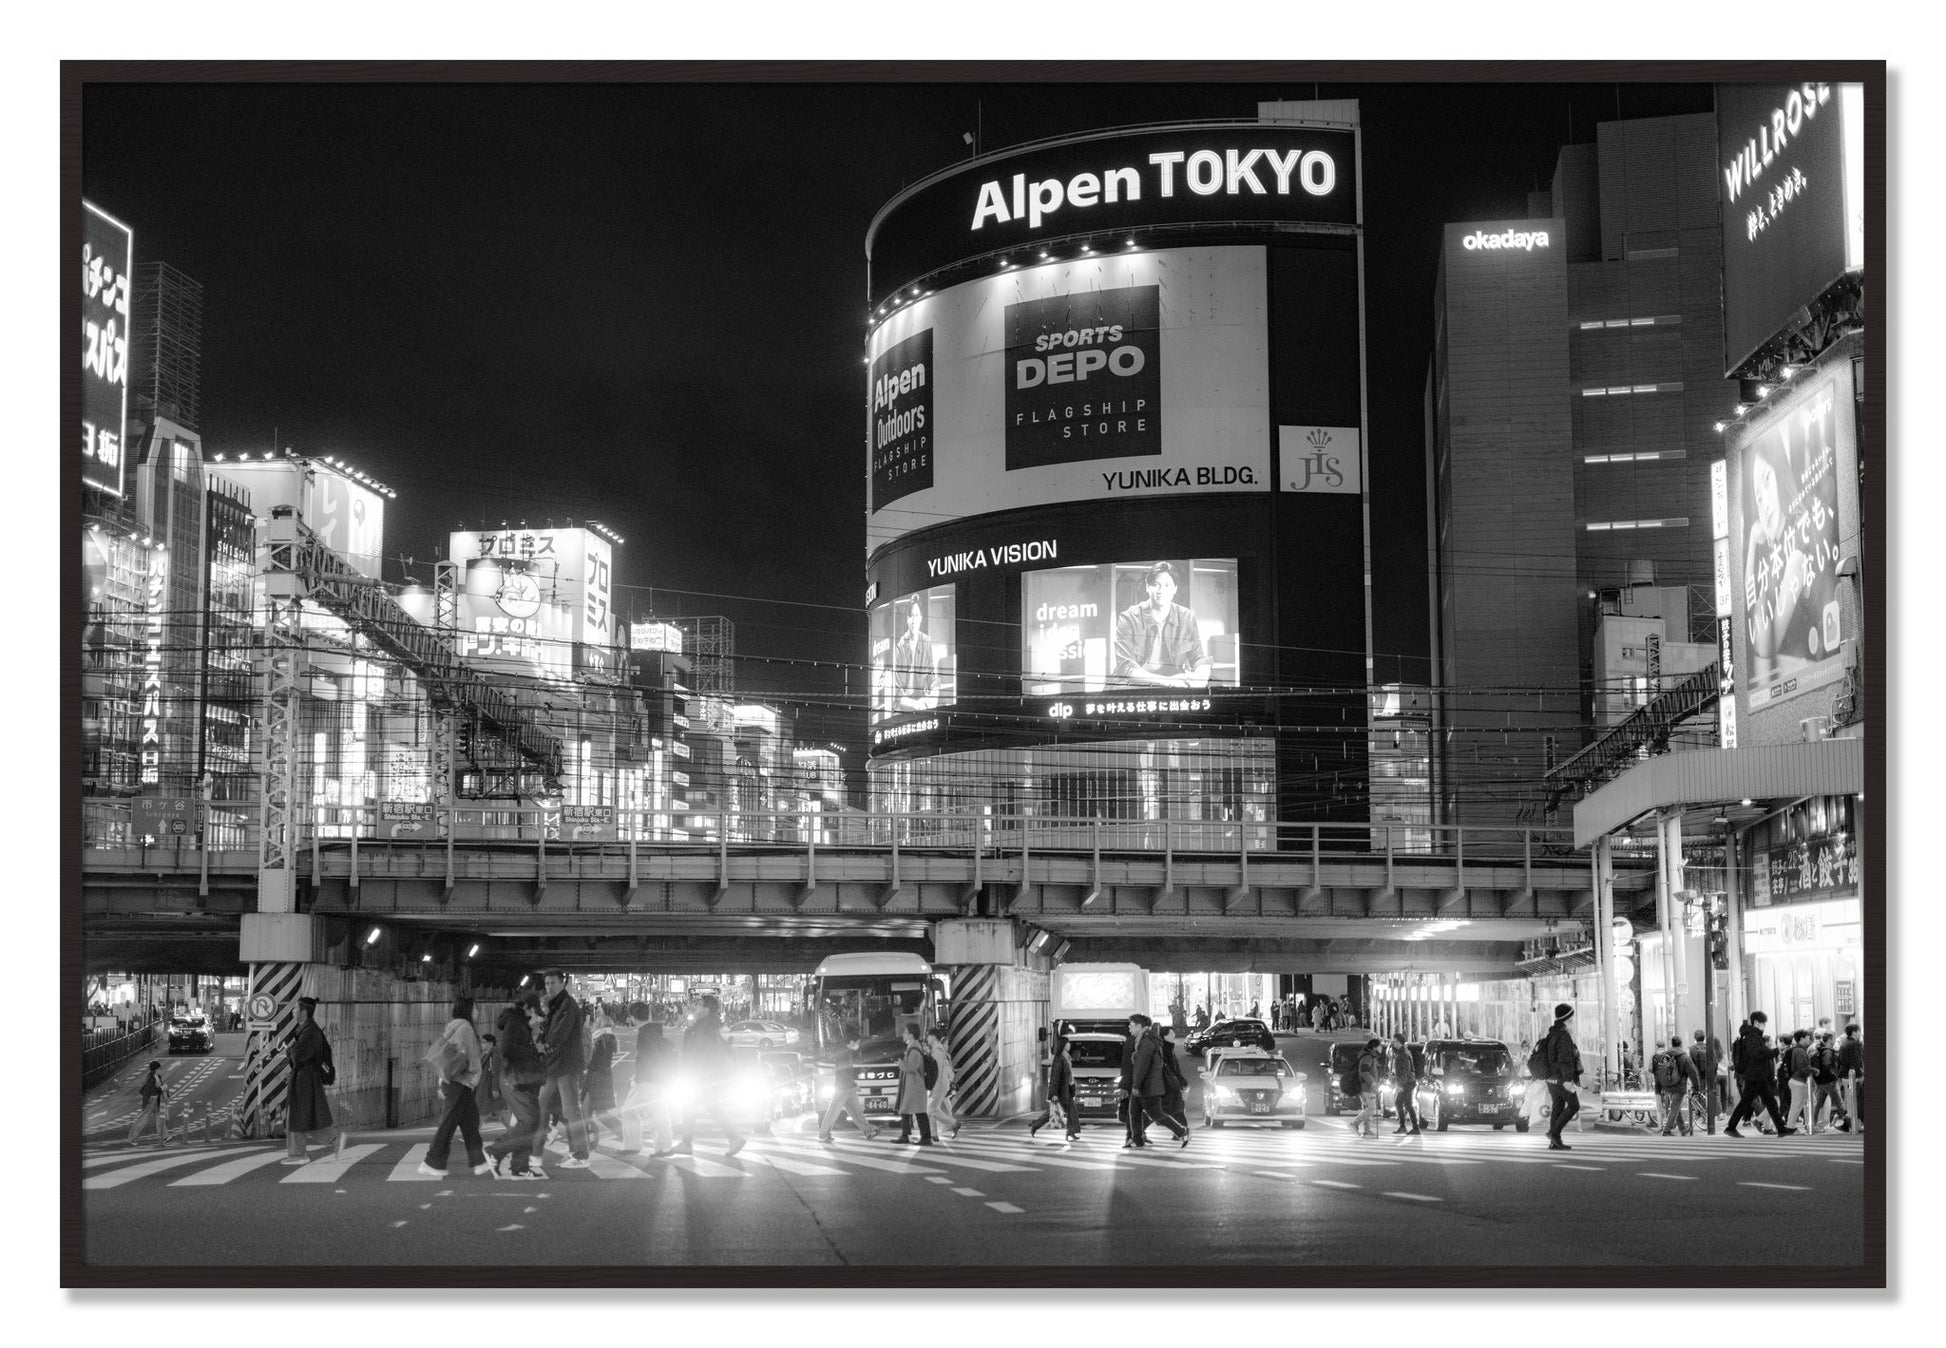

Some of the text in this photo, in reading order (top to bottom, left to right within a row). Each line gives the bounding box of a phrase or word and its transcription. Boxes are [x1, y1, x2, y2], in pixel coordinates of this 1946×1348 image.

[971, 149, 1336, 230] Alpen TOKYO
[1463, 230, 1550, 251] okadaya
[83, 318, 127, 384] スパス
[1035, 324, 1124, 352] SPORTS
[1016, 345, 1146, 389] DEPO
[874, 363, 926, 414] Alpen
[1016, 399, 1146, 426] FLAGSHIP
[877, 404, 925, 450] Outdoors
[1063, 419, 1146, 438] STORE
[874, 436, 927, 473] FLAGSHIP
[888, 455, 927, 481] STORE
[1102, 466, 1258, 491] YUNIKA BLDG.
[217, 541, 250, 563] SHISHA
[478, 534, 556, 558] プロミス
[928, 539, 1057, 577] YUNIKA VISION
[1744, 496, 1834, 613] 自分本位でも、
[1748, 538, 1839, 645] いいじゃない。
[1036, 602, 1098, 621] dream
[1049, 702, 1073, 719] dip
[1085, 699, 1211, 715] 夢を叶える仕事に出会おう
